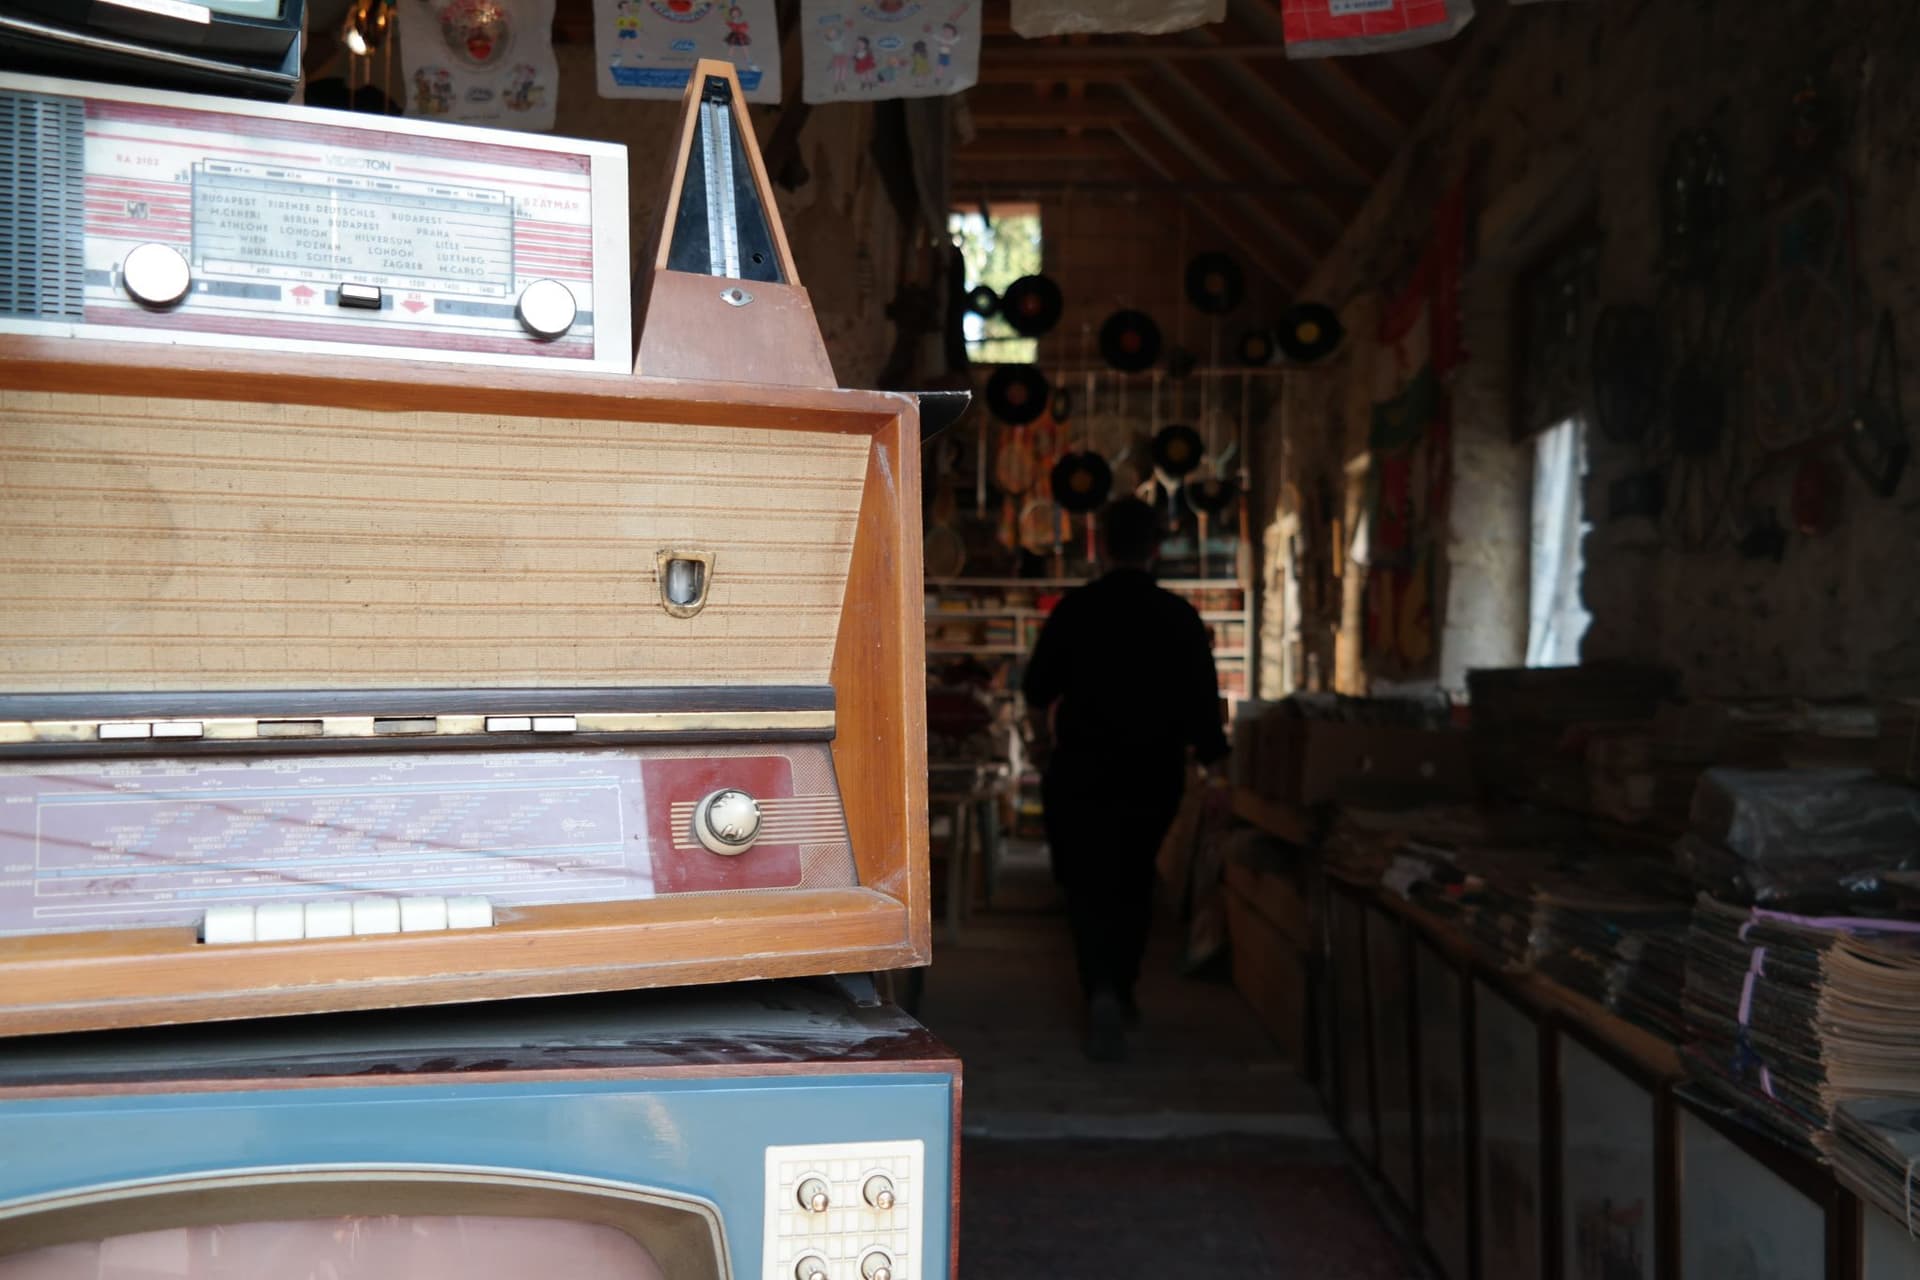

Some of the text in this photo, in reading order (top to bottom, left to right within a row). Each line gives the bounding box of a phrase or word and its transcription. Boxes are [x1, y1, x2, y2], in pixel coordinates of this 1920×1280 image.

[202, 193, 257, 206] BUDAPEST
[391, 212, 442, 224] BUDAPEST
[220, 220, 268, 232] ATHLONE
[280, 225, 328, 238] LONDON
[355, 233, 413, 245] HILVERSUM
[283, 214, 320, 225] BERLIN
[328, 218, 379, 231] BUDAPEST
[416, 227, 449, 238] PRAHA
[240, 246, 297, 260] BRUXELLES
[306, 252, 352, 264] SOTTENS
[383, 259, 423, 270] ZAGREB
[368, 247, 414, 257] LONDON
